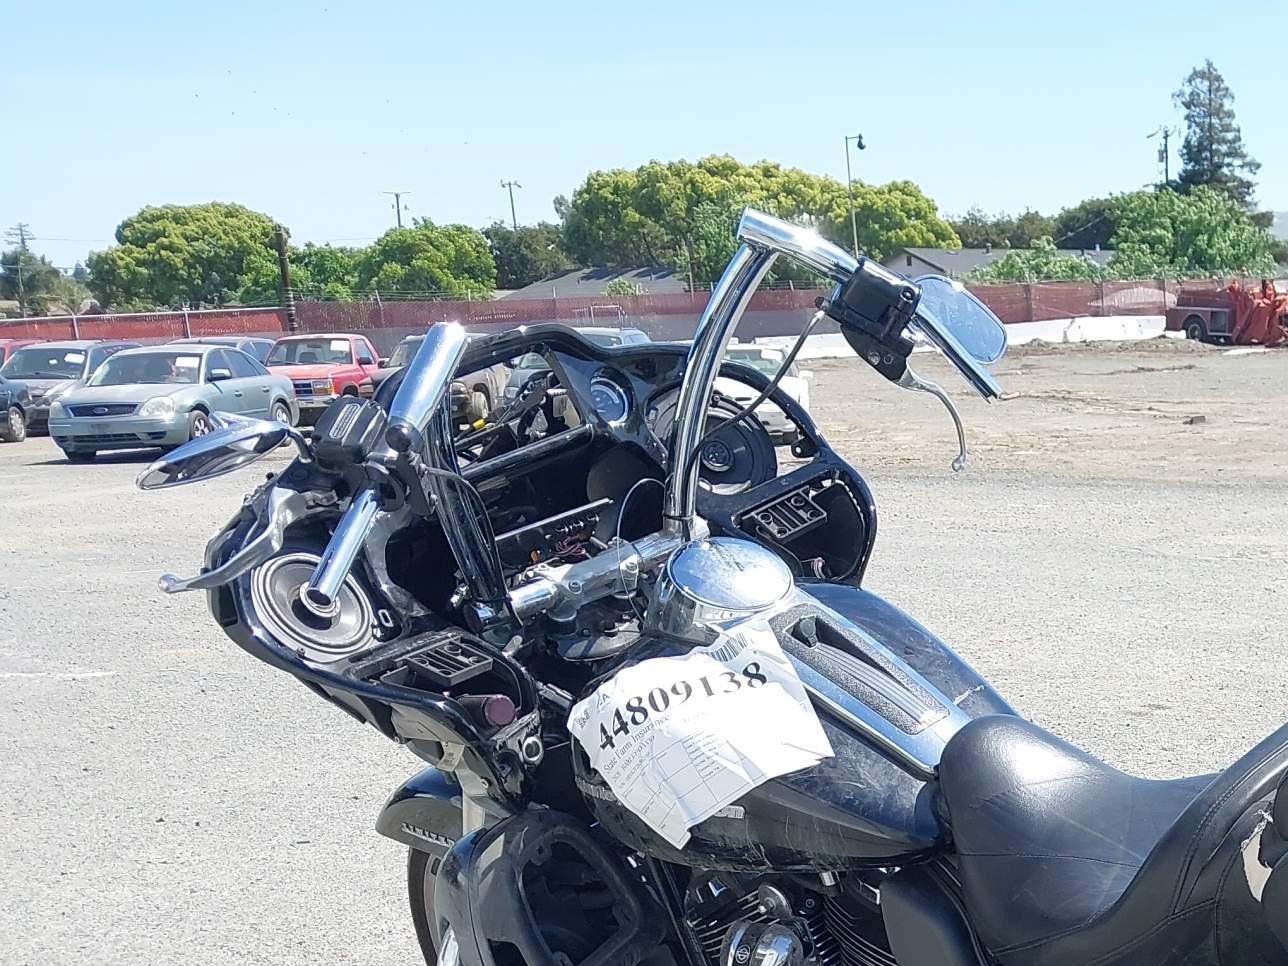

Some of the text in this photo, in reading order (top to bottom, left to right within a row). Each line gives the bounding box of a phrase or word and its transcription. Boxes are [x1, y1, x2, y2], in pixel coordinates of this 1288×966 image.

[600, 662, 768, 751] 44809138
[614, 740, 633, 758] Farm
[630, 714, 670, 743] Insurance
